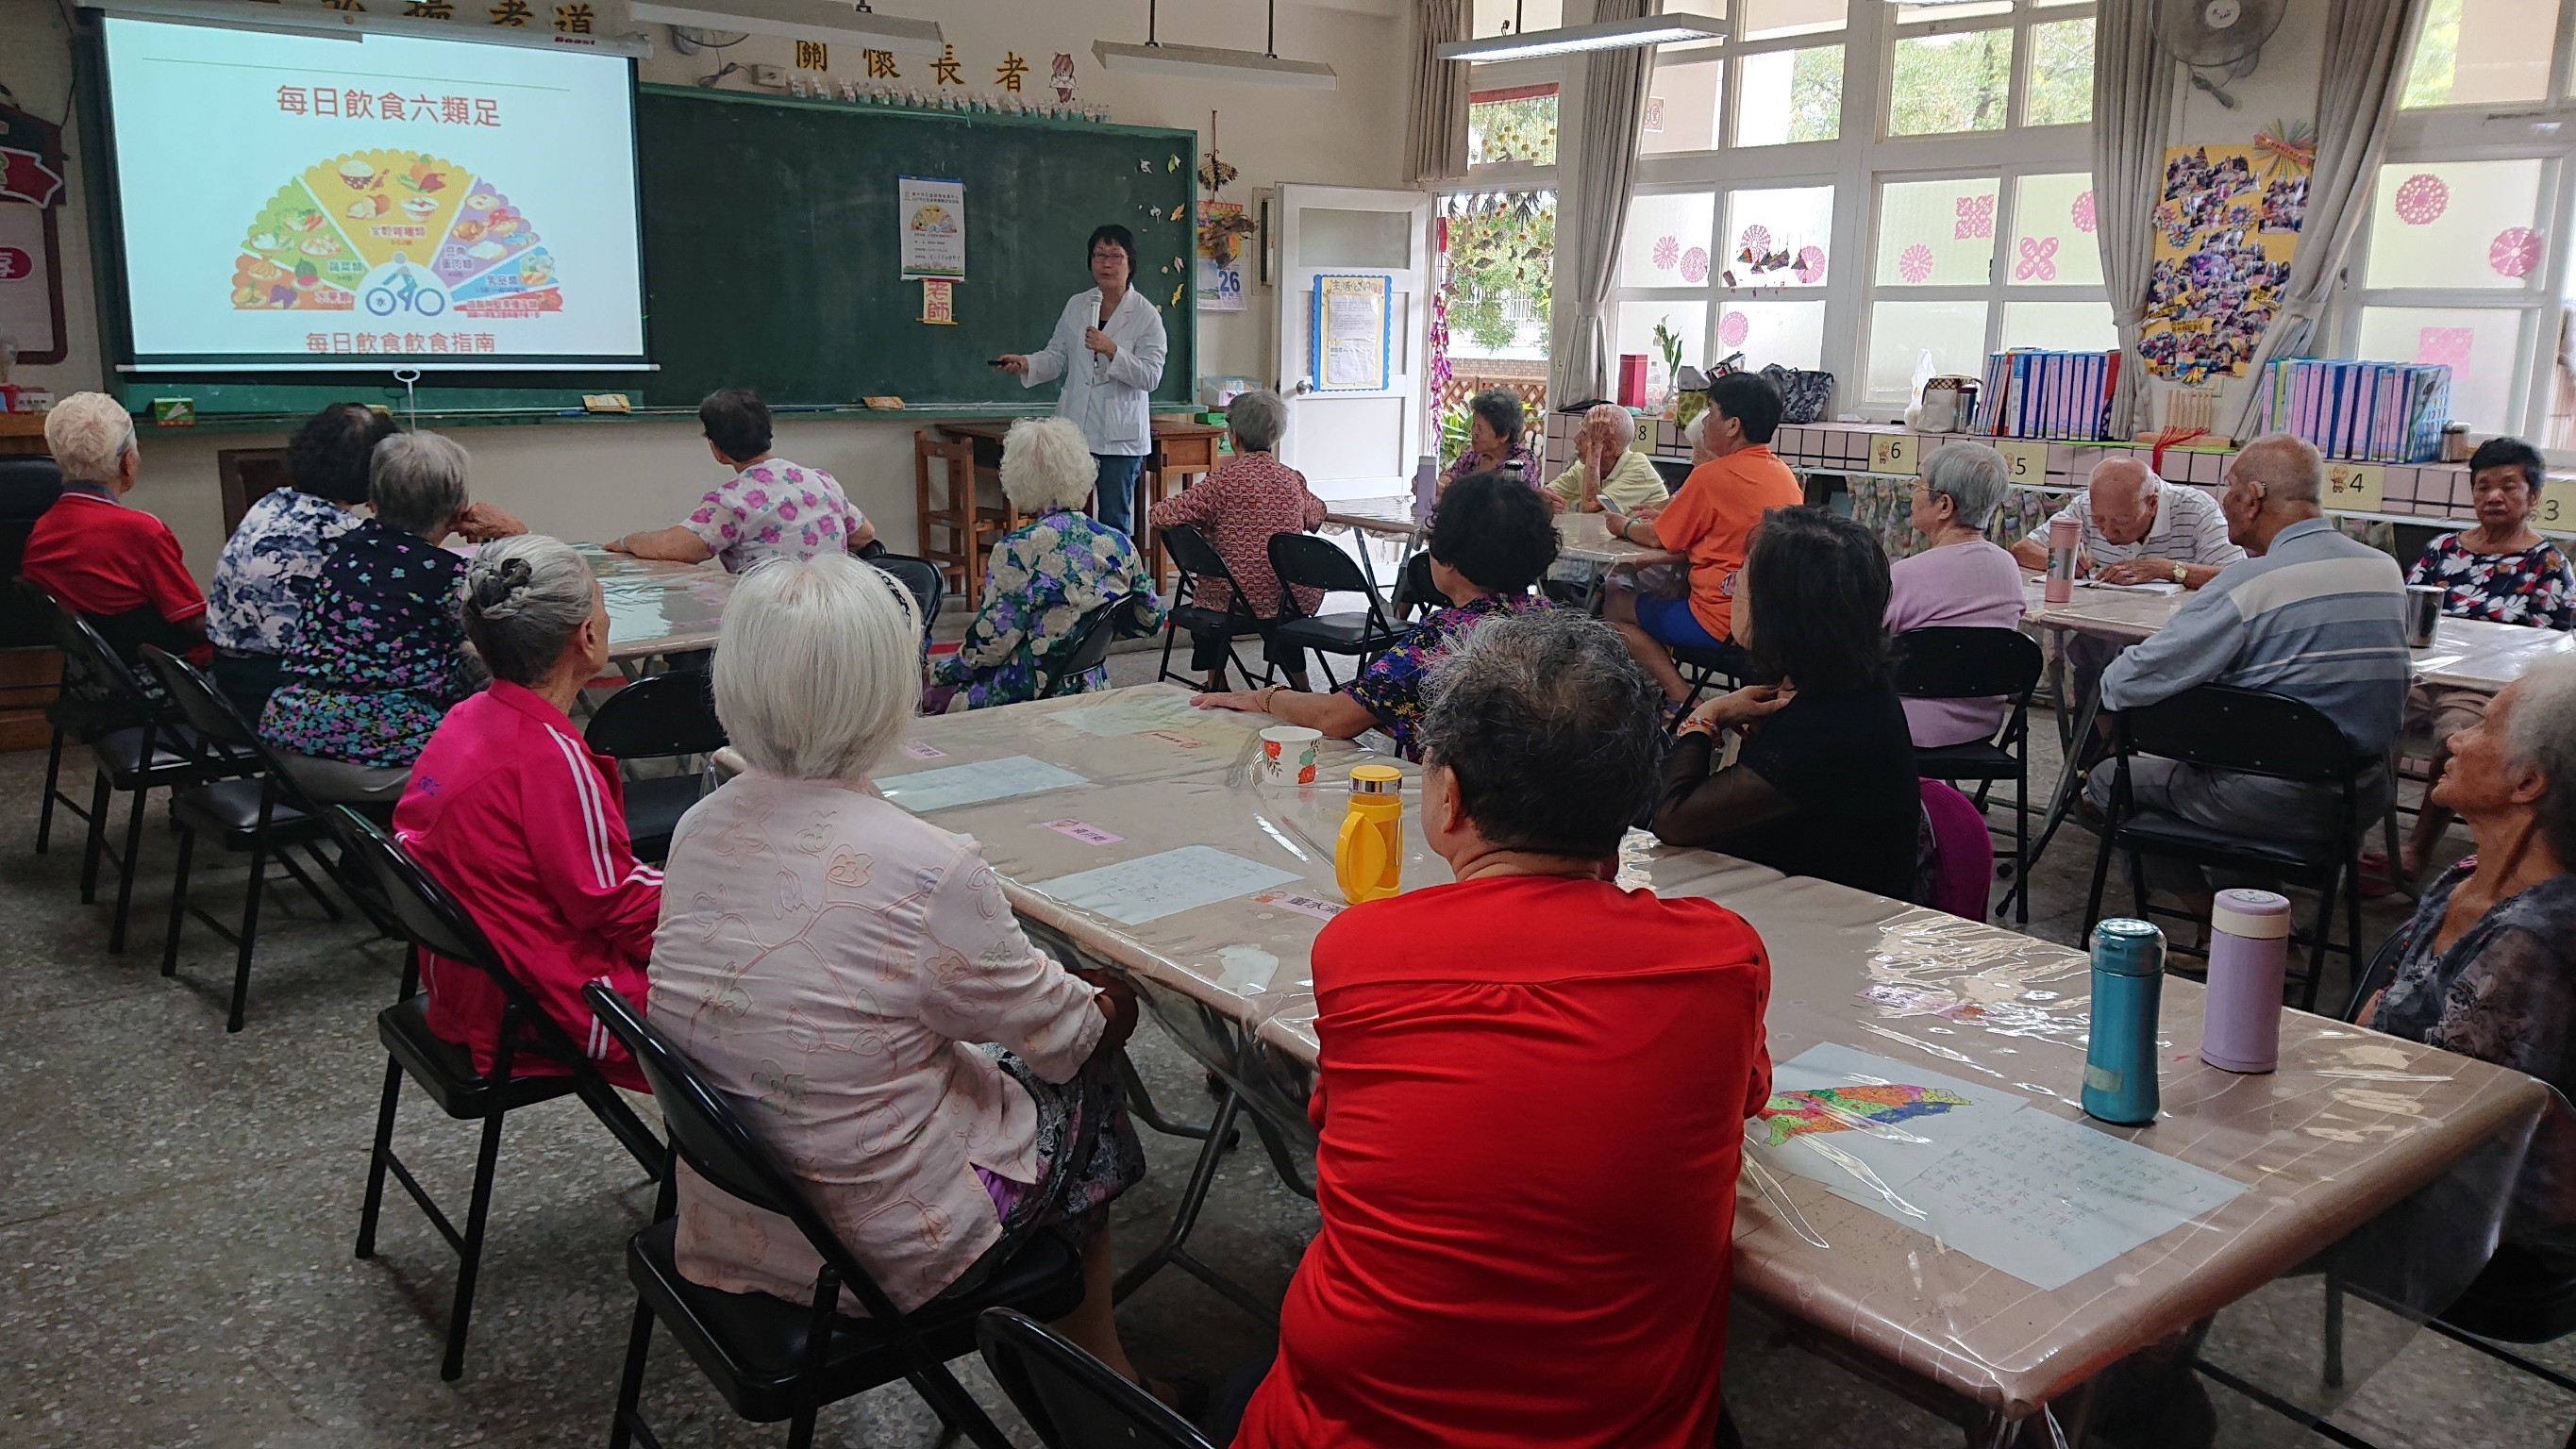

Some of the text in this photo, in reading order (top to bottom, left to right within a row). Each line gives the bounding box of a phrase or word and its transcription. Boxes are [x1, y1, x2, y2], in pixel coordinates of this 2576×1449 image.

[276, 85, 502, 127] 每日飲食六類足
[1218, 270, 1241, 293] 26
[926, 282, 950, 321] 老師
[306, 332, 495, 354] 每日飲食飲食指南
[1638, 425, 1647, 441] 8
[1891, 441, 1901, 459] 6
[2015, 458, 2027, 475] 5
[2350, 473, 2364, 493] 4
[2544, 499, 2560, 521] 3
